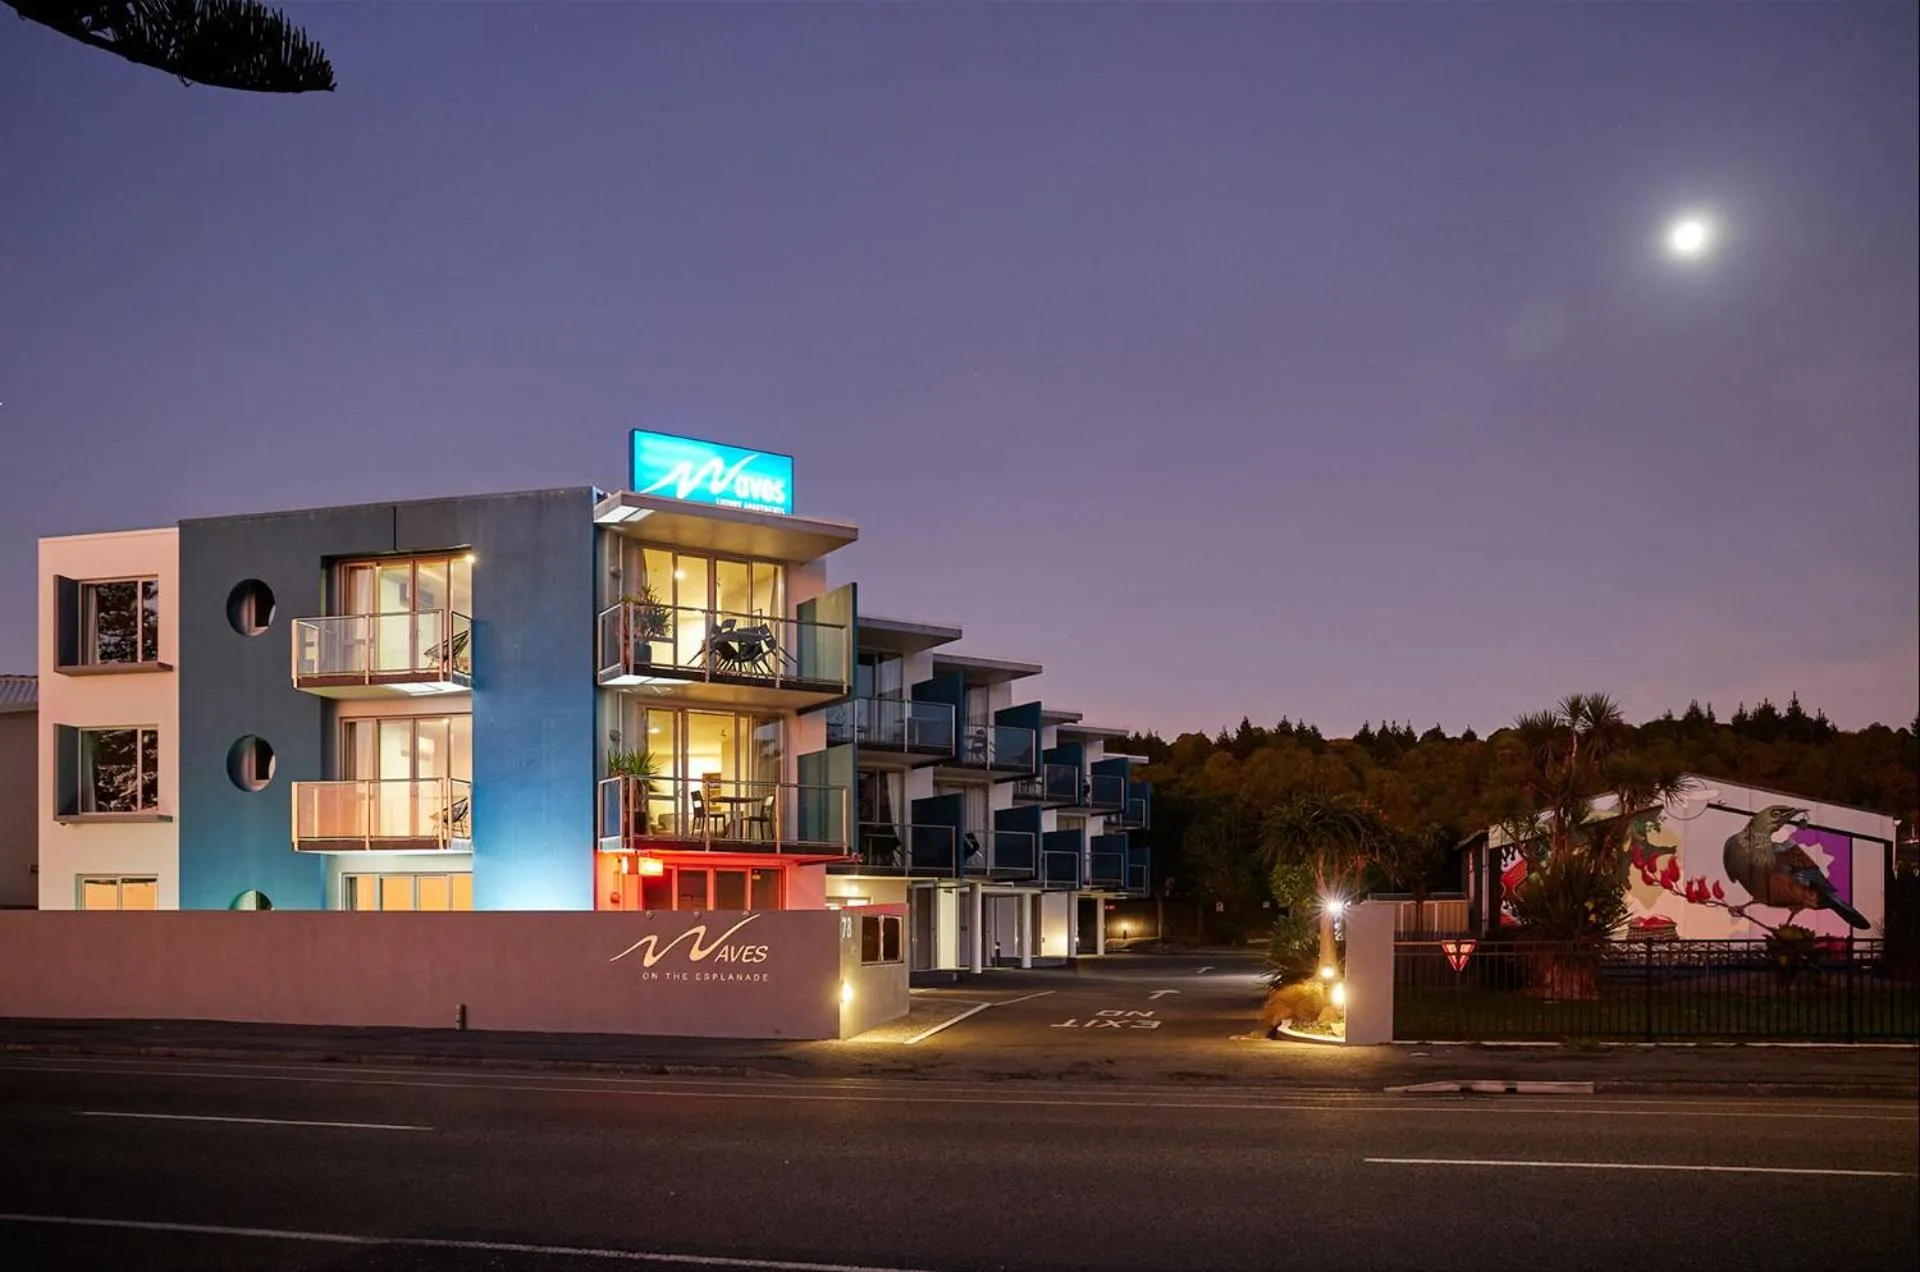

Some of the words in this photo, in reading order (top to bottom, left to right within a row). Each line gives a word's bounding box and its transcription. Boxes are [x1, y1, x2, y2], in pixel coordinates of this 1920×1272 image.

[642, 972, 658, 980] ON
[665, 972, 688, 981] THE
[695, 972, 769, 982] ESPLANADE
[1050, 1019, 1162, 1029] EXIT
